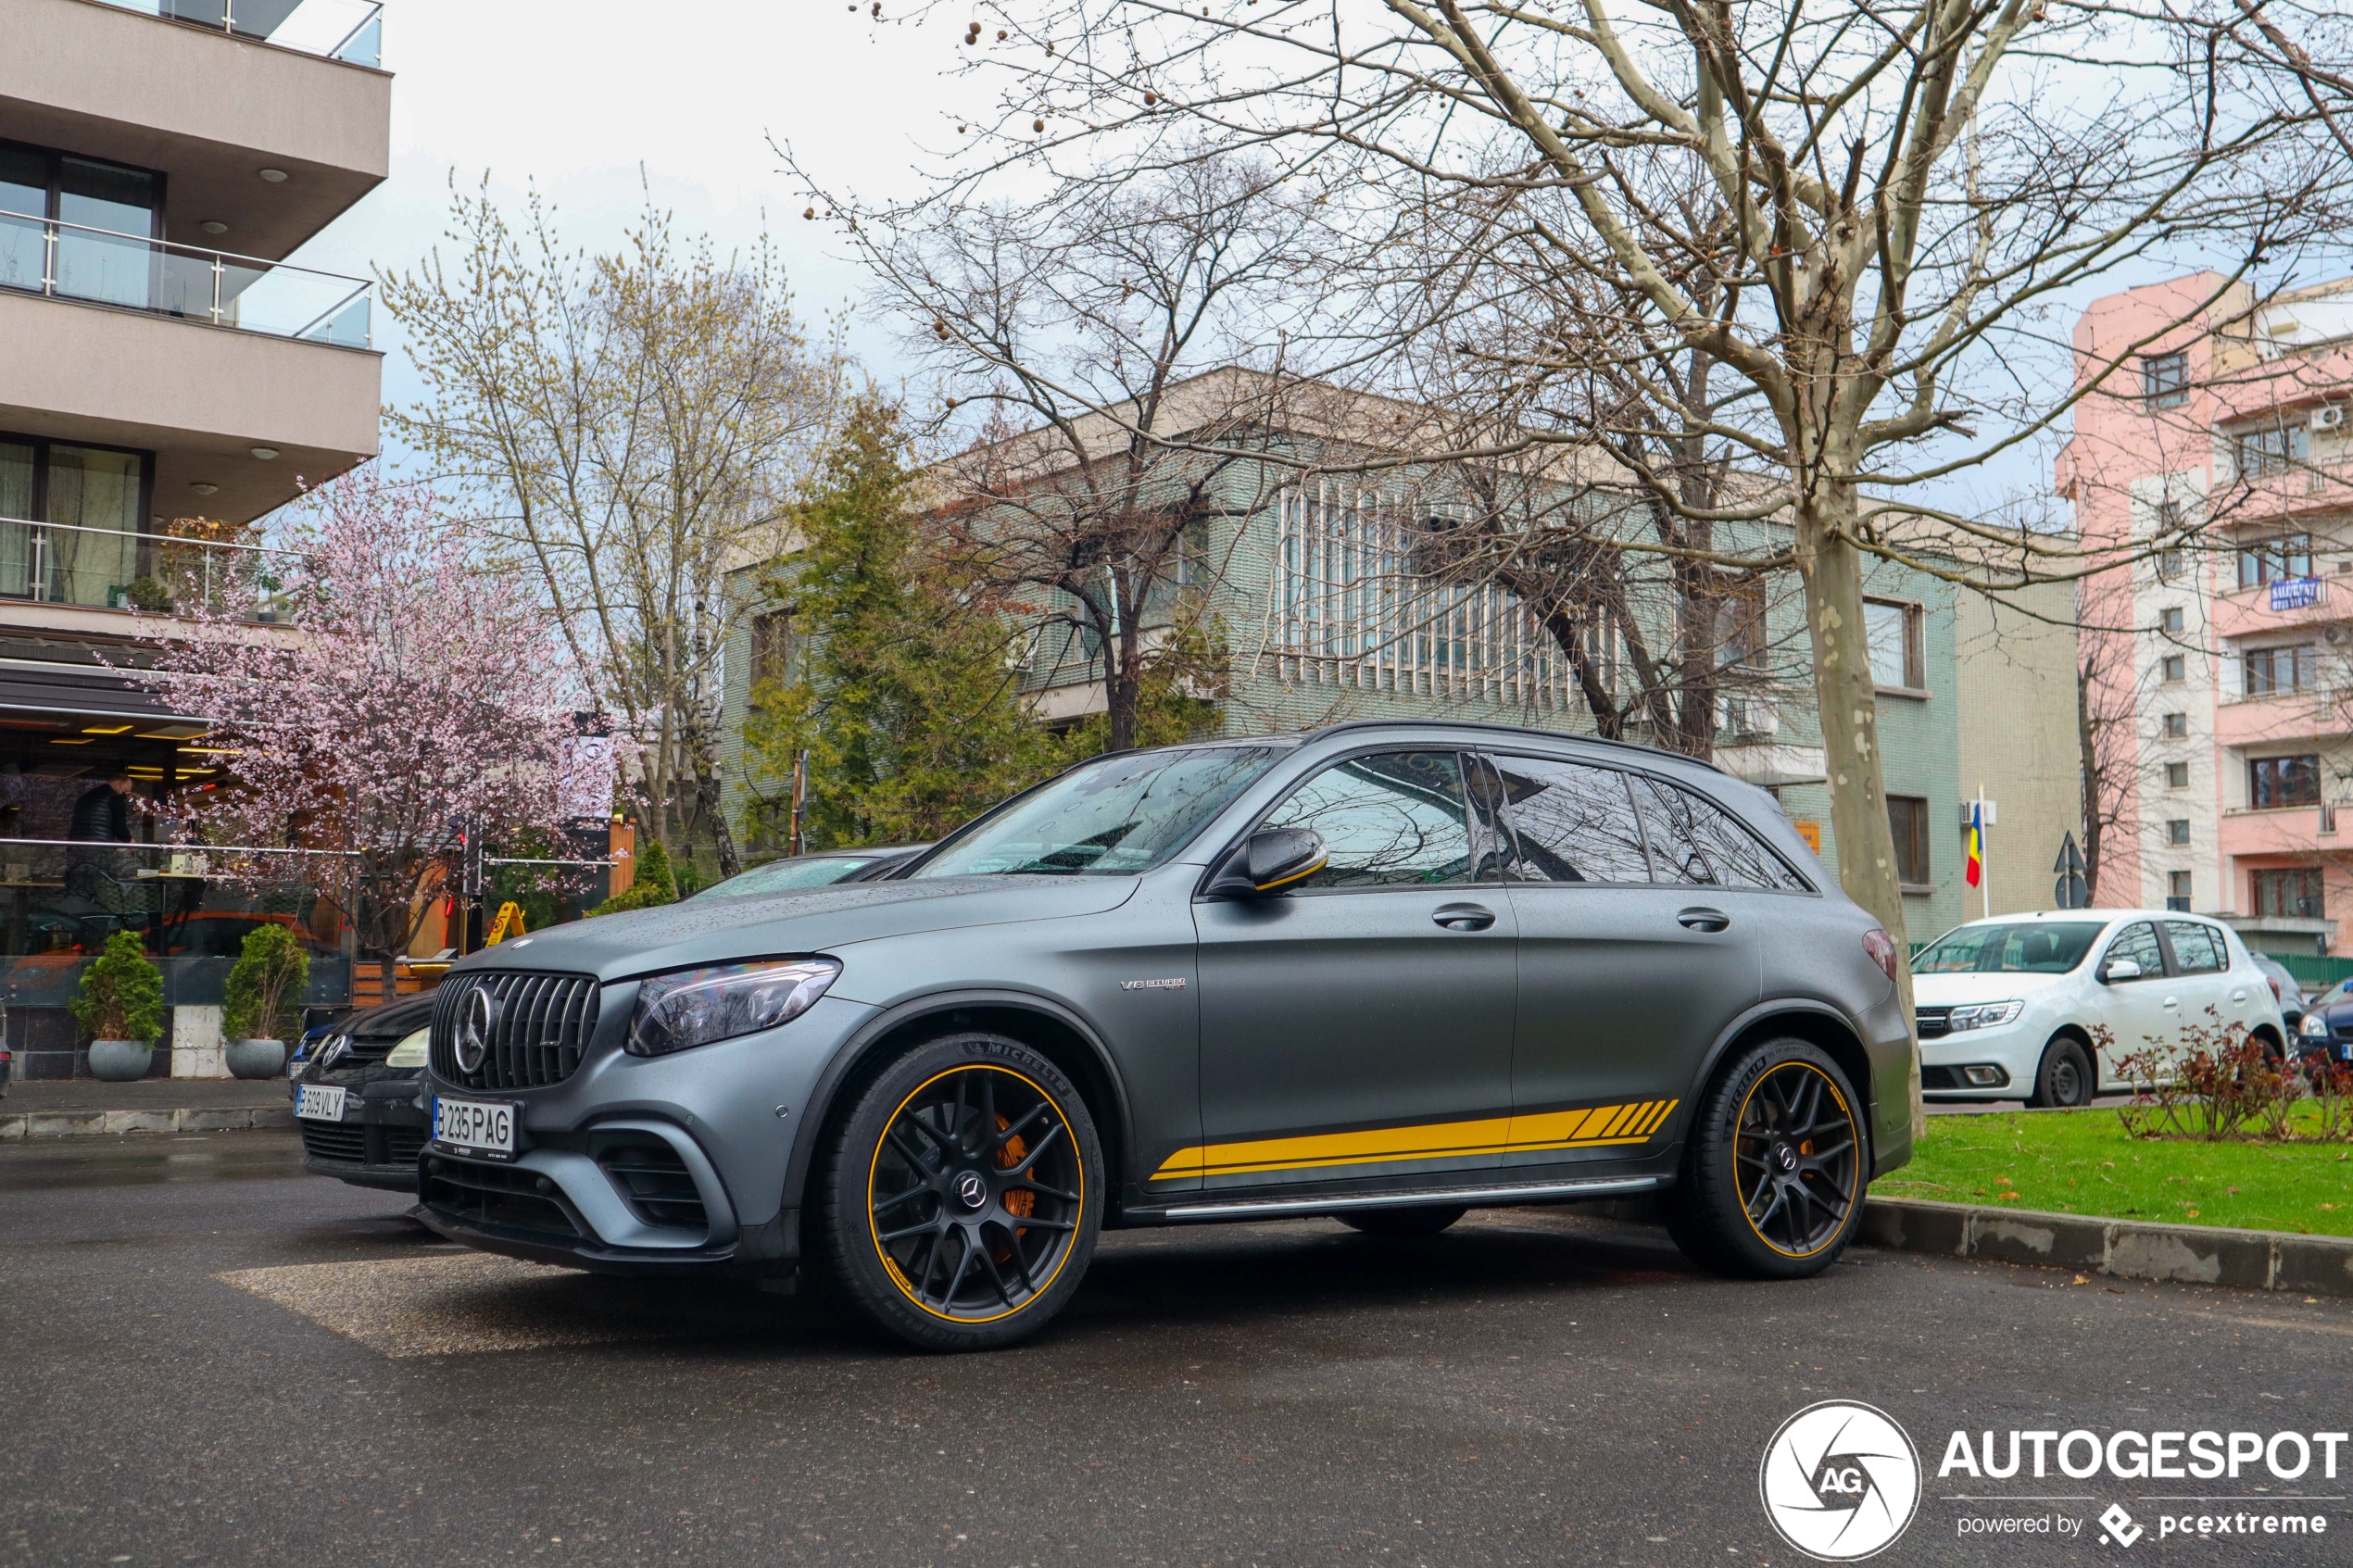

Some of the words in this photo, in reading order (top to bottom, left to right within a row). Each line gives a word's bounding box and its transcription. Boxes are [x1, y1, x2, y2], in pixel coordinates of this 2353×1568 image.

[1120, 981, 1145, 990] V8
[1147, 978, 1185, 986] BITURBO
[990, 1043, 1067, 1091] MICHELIN
[1728, 1056, 1766, 1123] MICHELIN
[438, 1103, 445, 1135] B
[448, 1105, 470, 1140] 235
[472, 1107, 509, 1144] PAG
